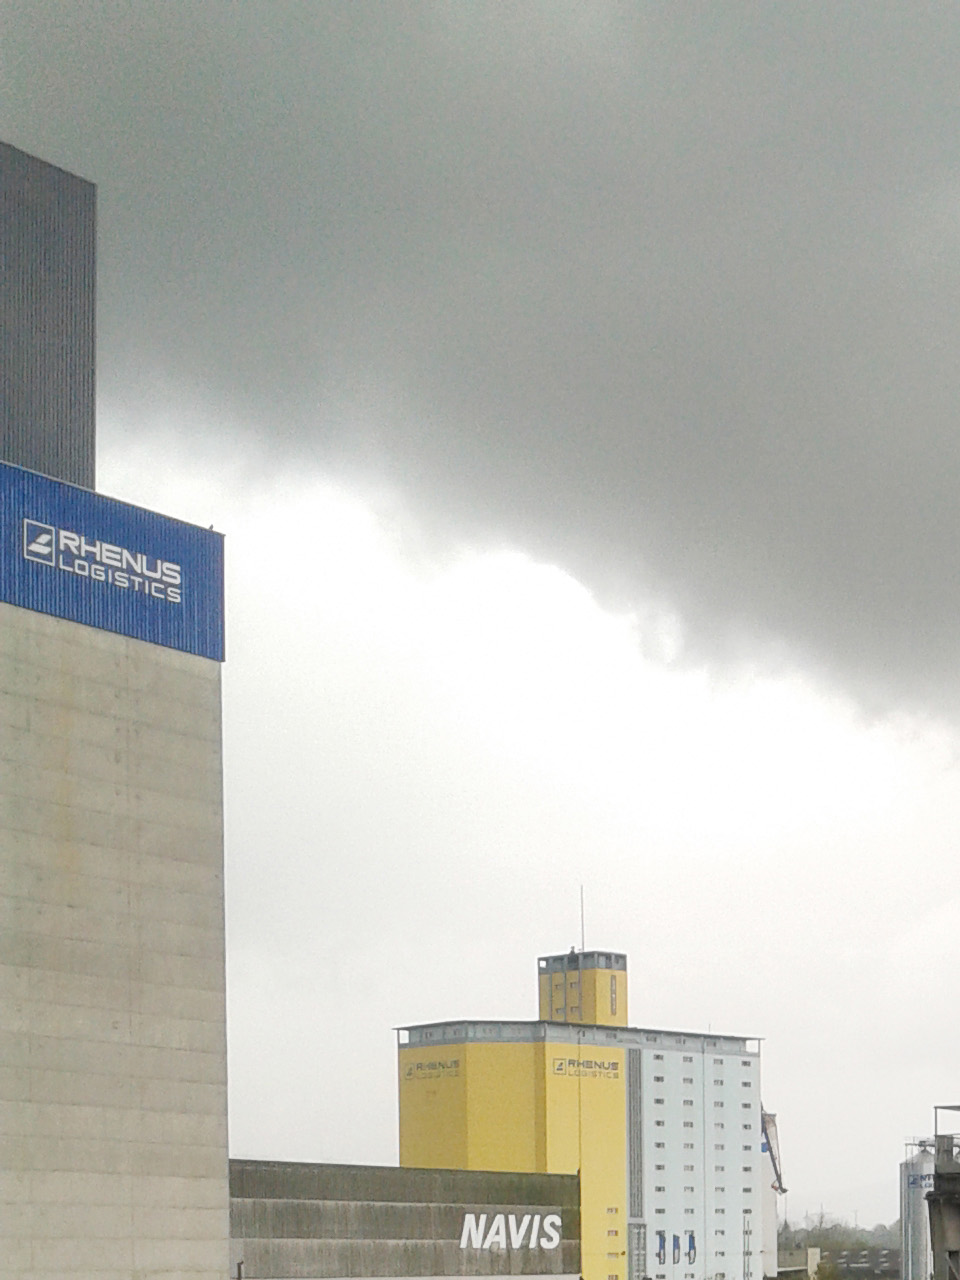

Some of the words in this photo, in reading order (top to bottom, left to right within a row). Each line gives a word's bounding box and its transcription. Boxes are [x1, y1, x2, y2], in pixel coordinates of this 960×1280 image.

[59, 530, 181, 585] RHENUS
[59, 554, 181, 603] LOGISTICS
[567, 1059, 619, 1071] RHENUS
[460, 1213, 562, 1249] NAVIS
